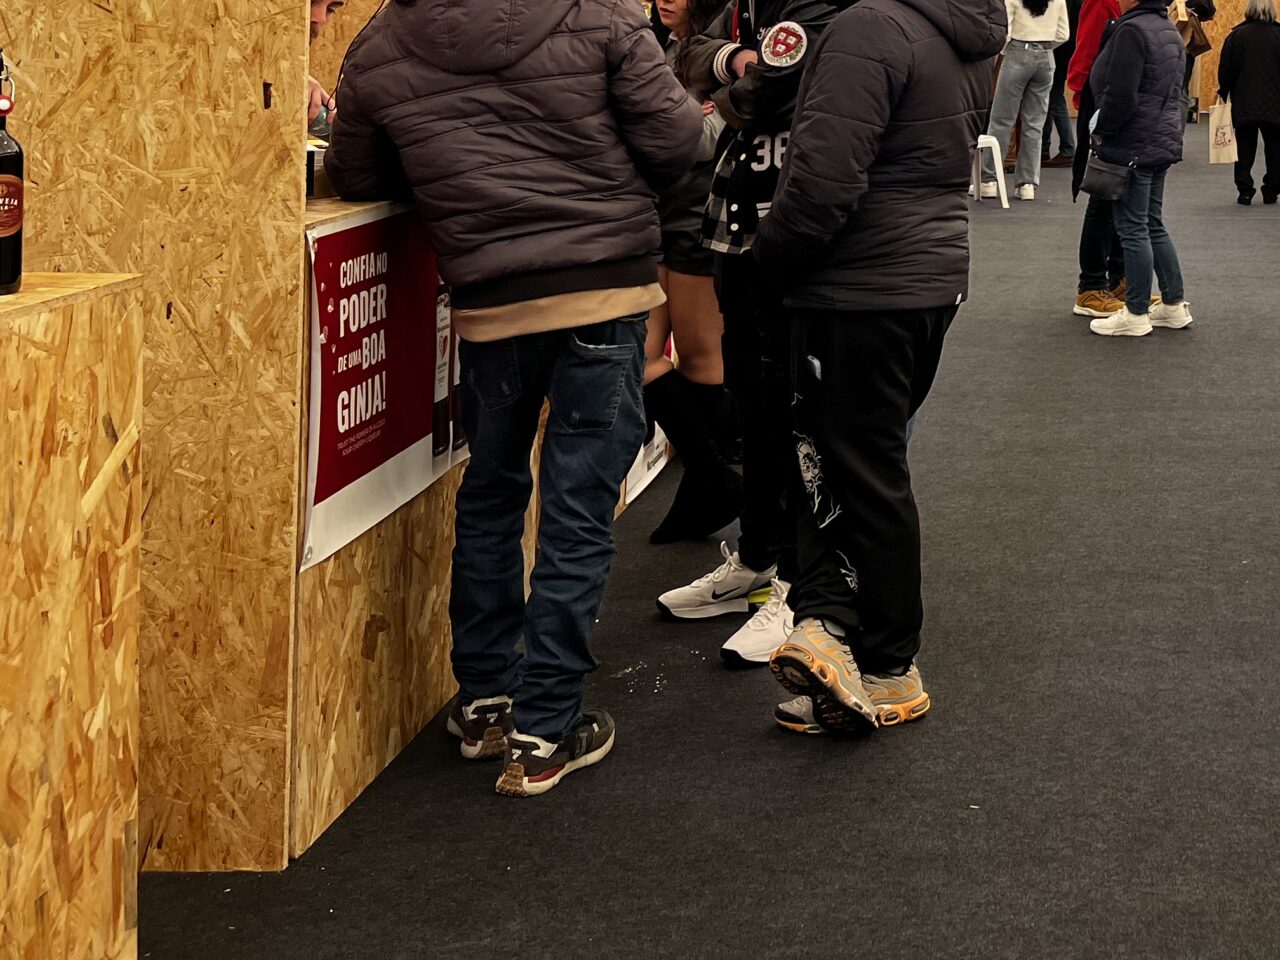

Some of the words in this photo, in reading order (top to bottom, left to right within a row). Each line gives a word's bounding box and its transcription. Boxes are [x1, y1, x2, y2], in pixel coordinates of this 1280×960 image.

[0, 197, 18, 206] VEJA
[340, 252, 375, 289] CONFIA
[376, 252, 388, 275] NO
[340, 283, 387, 338] PODER
[337, 354, 348, 374] DE
[348, 348, 362, 369] UMA
[362, 329, 386, 371] BOA
[337, 370, 386, 434] GINJA!
